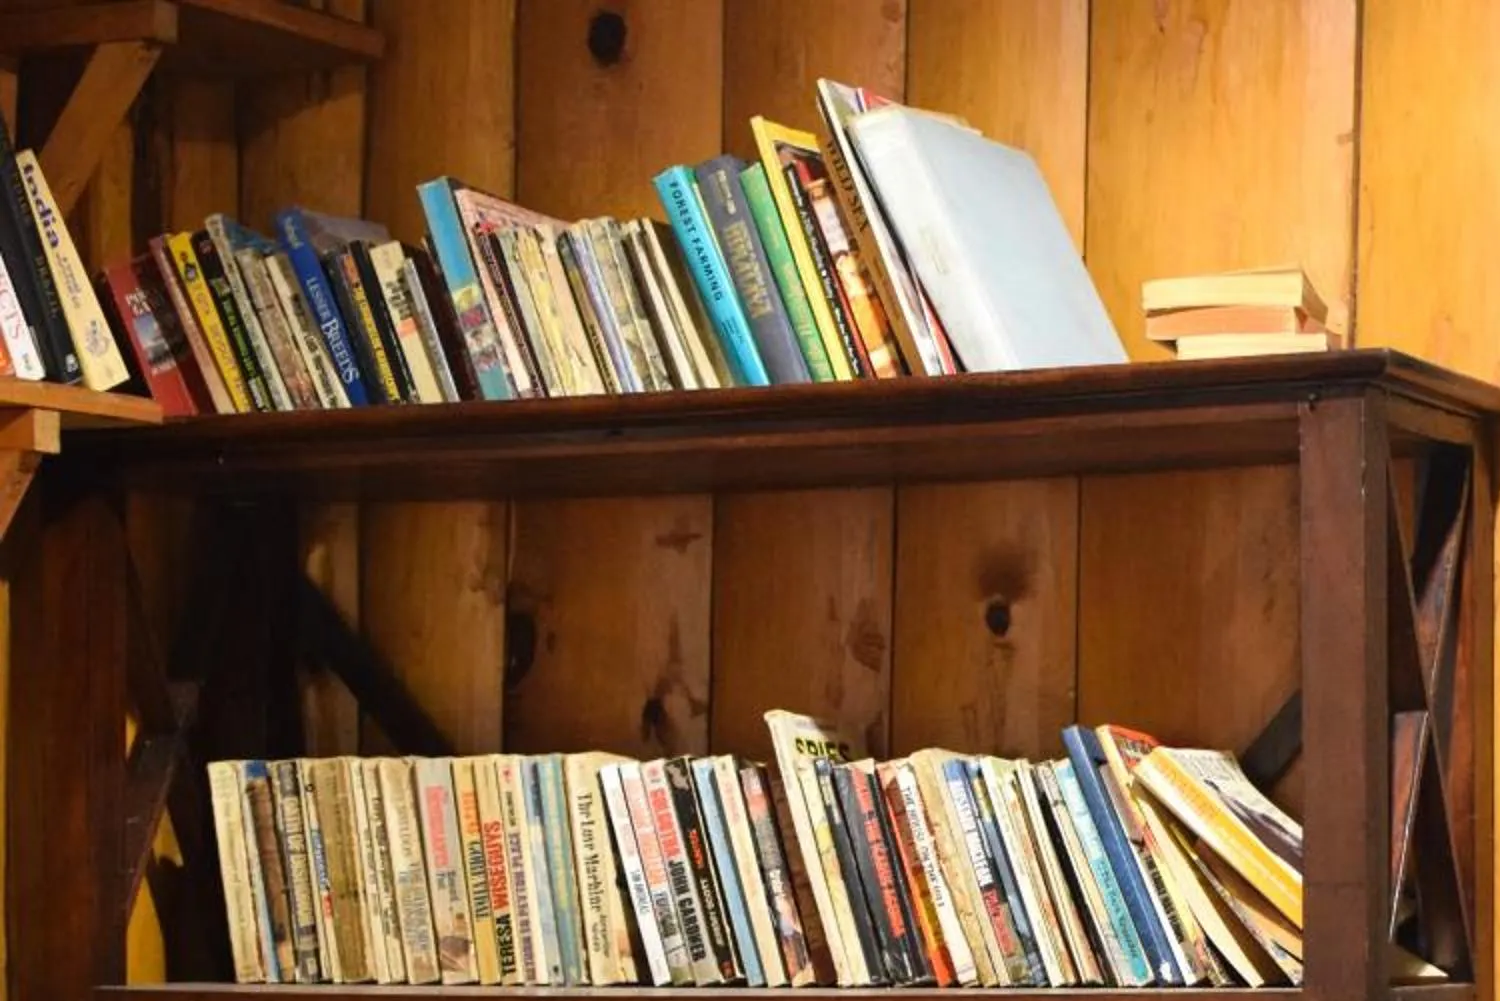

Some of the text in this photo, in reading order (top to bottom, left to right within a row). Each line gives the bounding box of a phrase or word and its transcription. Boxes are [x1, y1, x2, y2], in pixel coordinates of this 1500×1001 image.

[22, 163, 61, 248] India
[668, 180, 722, 302] FOREST FARMING
[320, 318, 360, 385] BREEDS
[482, 821, 510, 911] WISEGUYS
[511, 870, 529, 917] PEYTON
[576, 791, 605, 913] The Love Machine
[495, 914, 518, 976] TERESA
[667, 859, 707, 961] JOHN GARDNER
